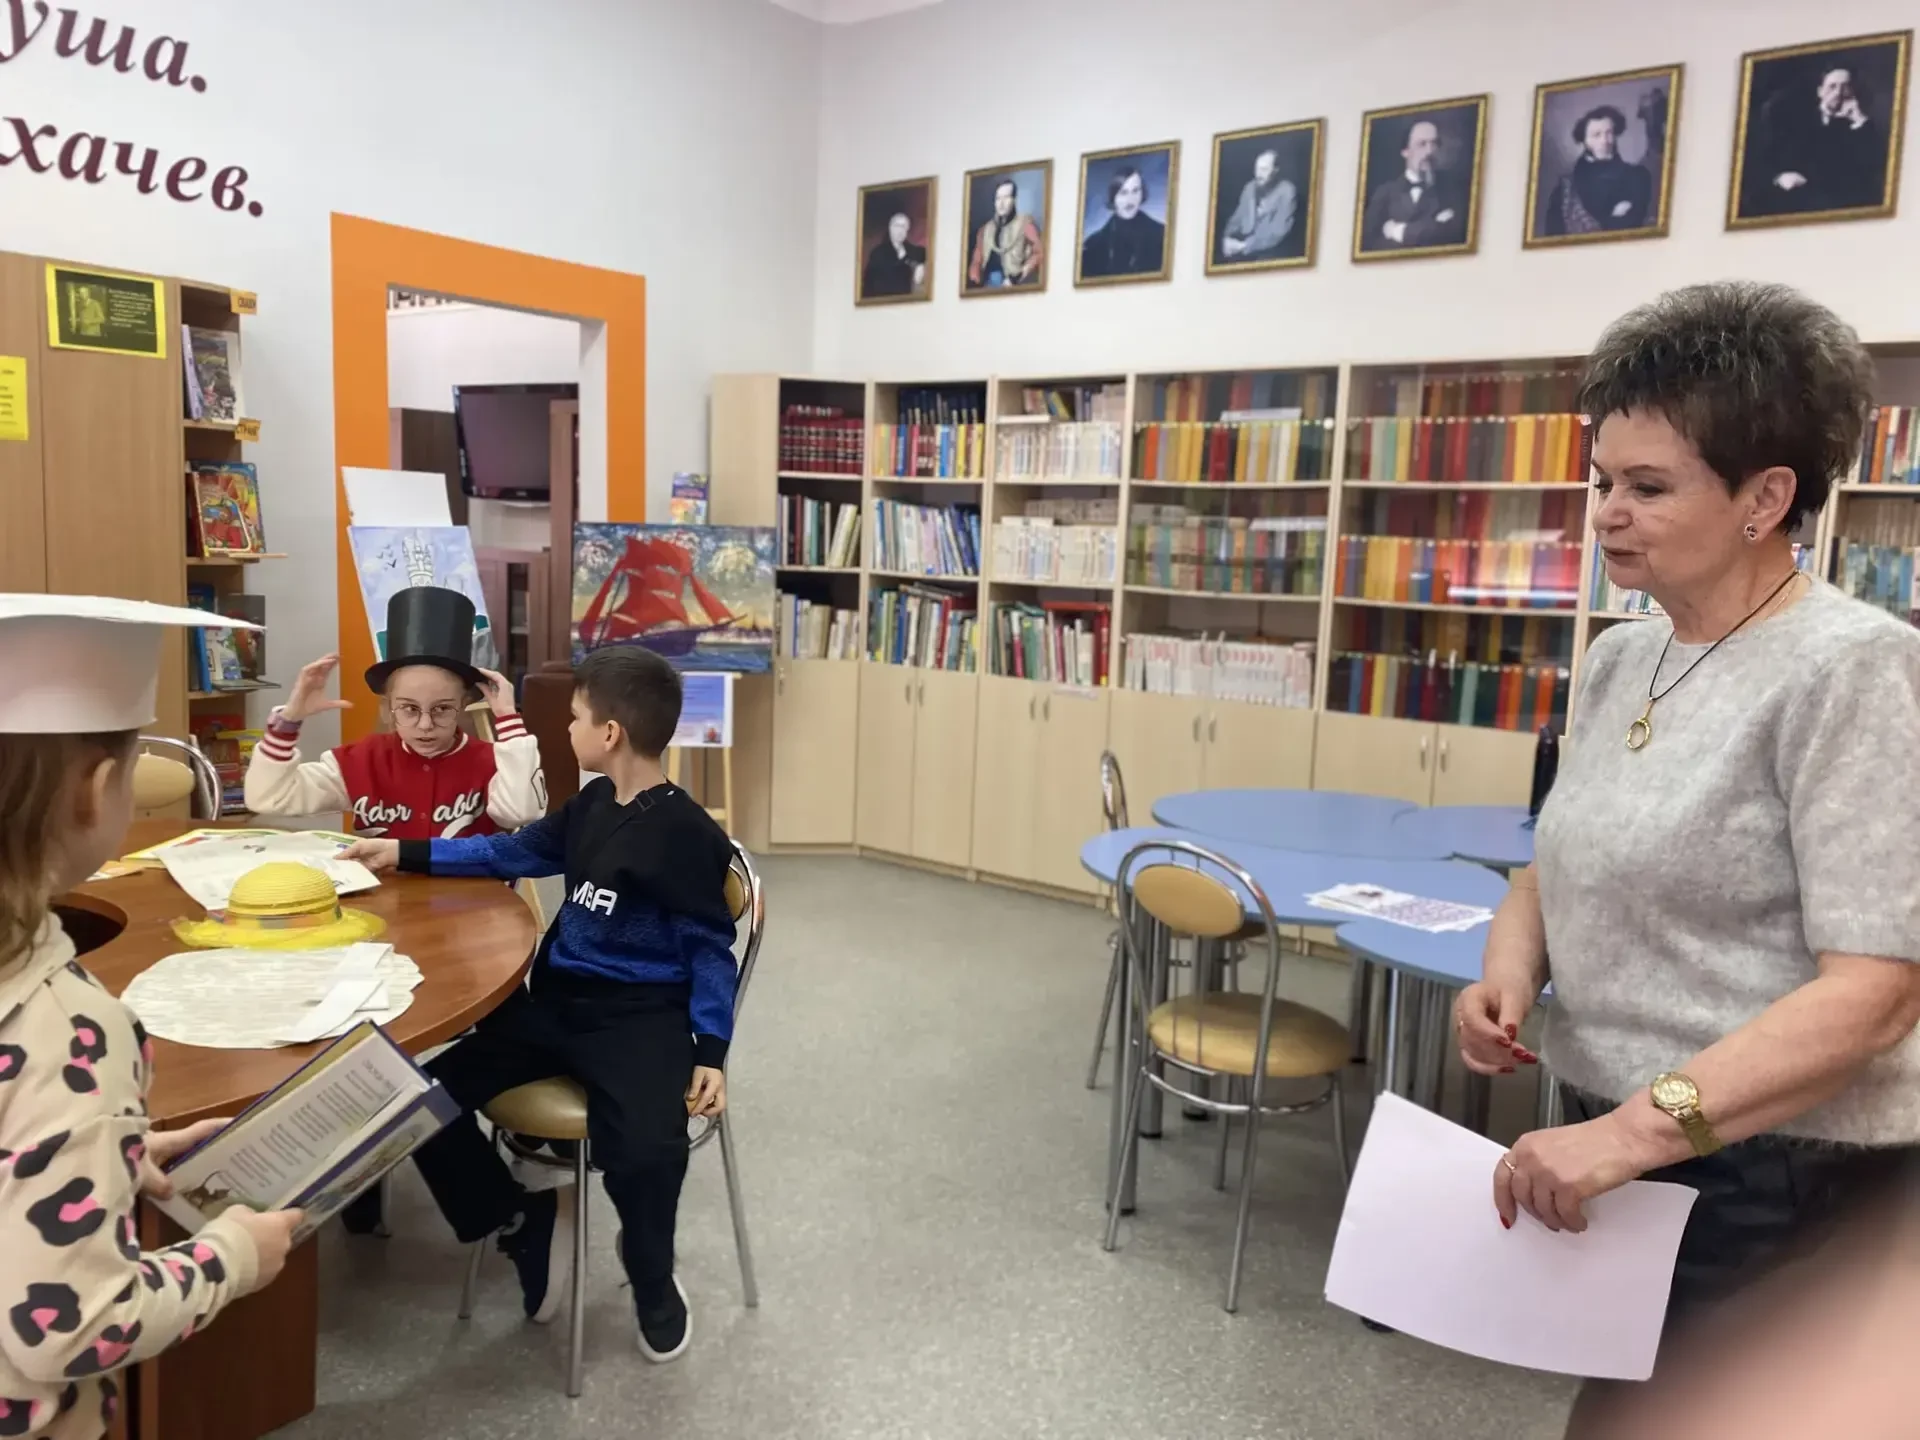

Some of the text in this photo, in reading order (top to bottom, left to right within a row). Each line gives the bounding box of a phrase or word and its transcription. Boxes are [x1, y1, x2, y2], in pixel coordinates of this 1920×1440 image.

[0, 0, 207, 93] уша.
[0, 117, 263, 218] хачев.
[352, 795, 412, 827] Ador
